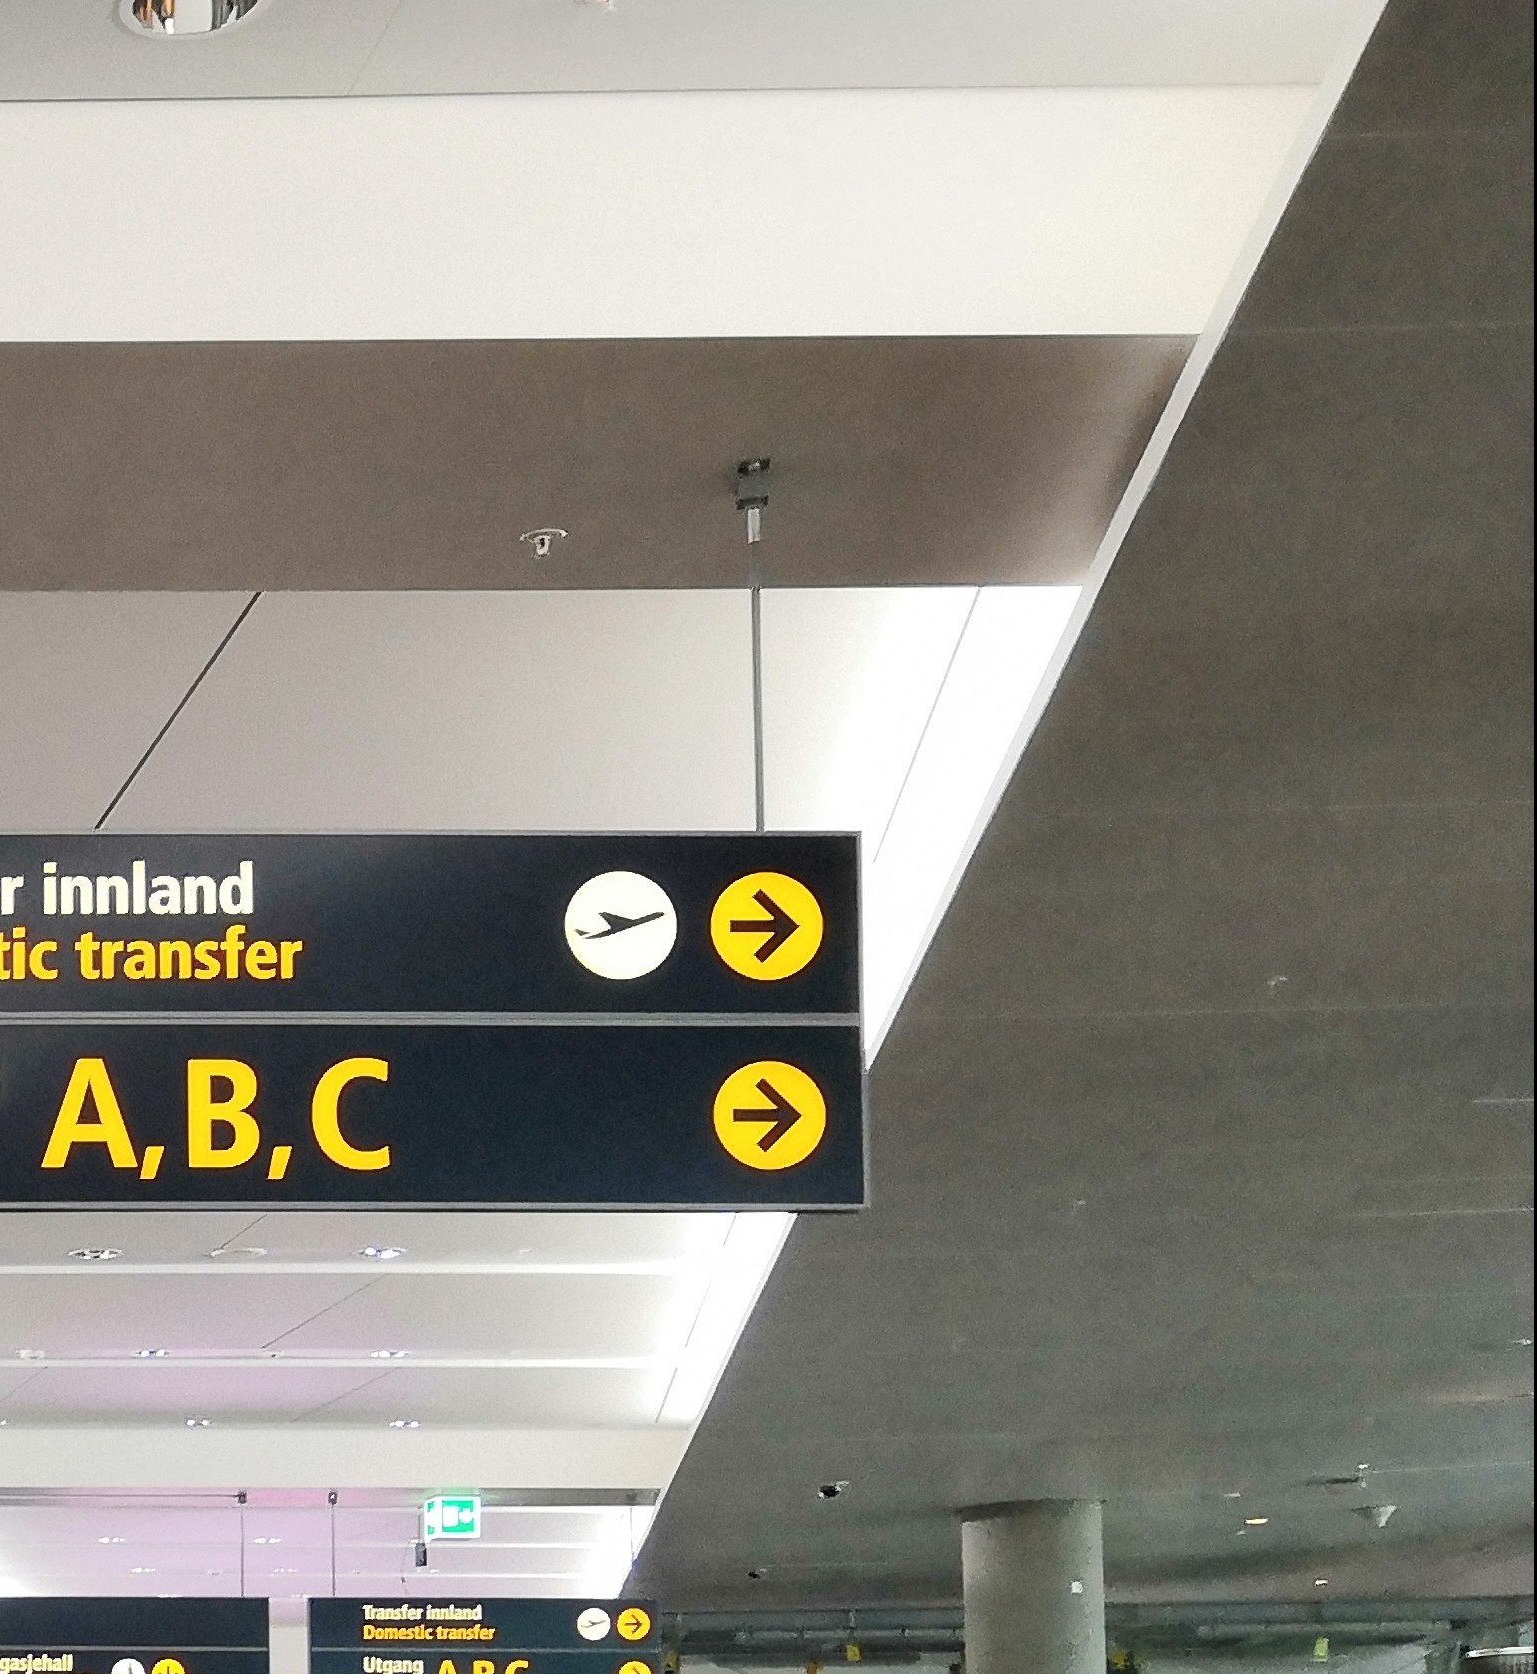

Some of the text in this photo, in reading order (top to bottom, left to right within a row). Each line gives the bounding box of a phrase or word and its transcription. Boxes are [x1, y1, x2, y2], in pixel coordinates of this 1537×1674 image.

[42, 859, 255, 917] innland
[75, 925, 304, 982] transfer
[362, 1604, 483, 1620] Transfer innland
[363, 1624, 496, 1640] Domestic transfer
